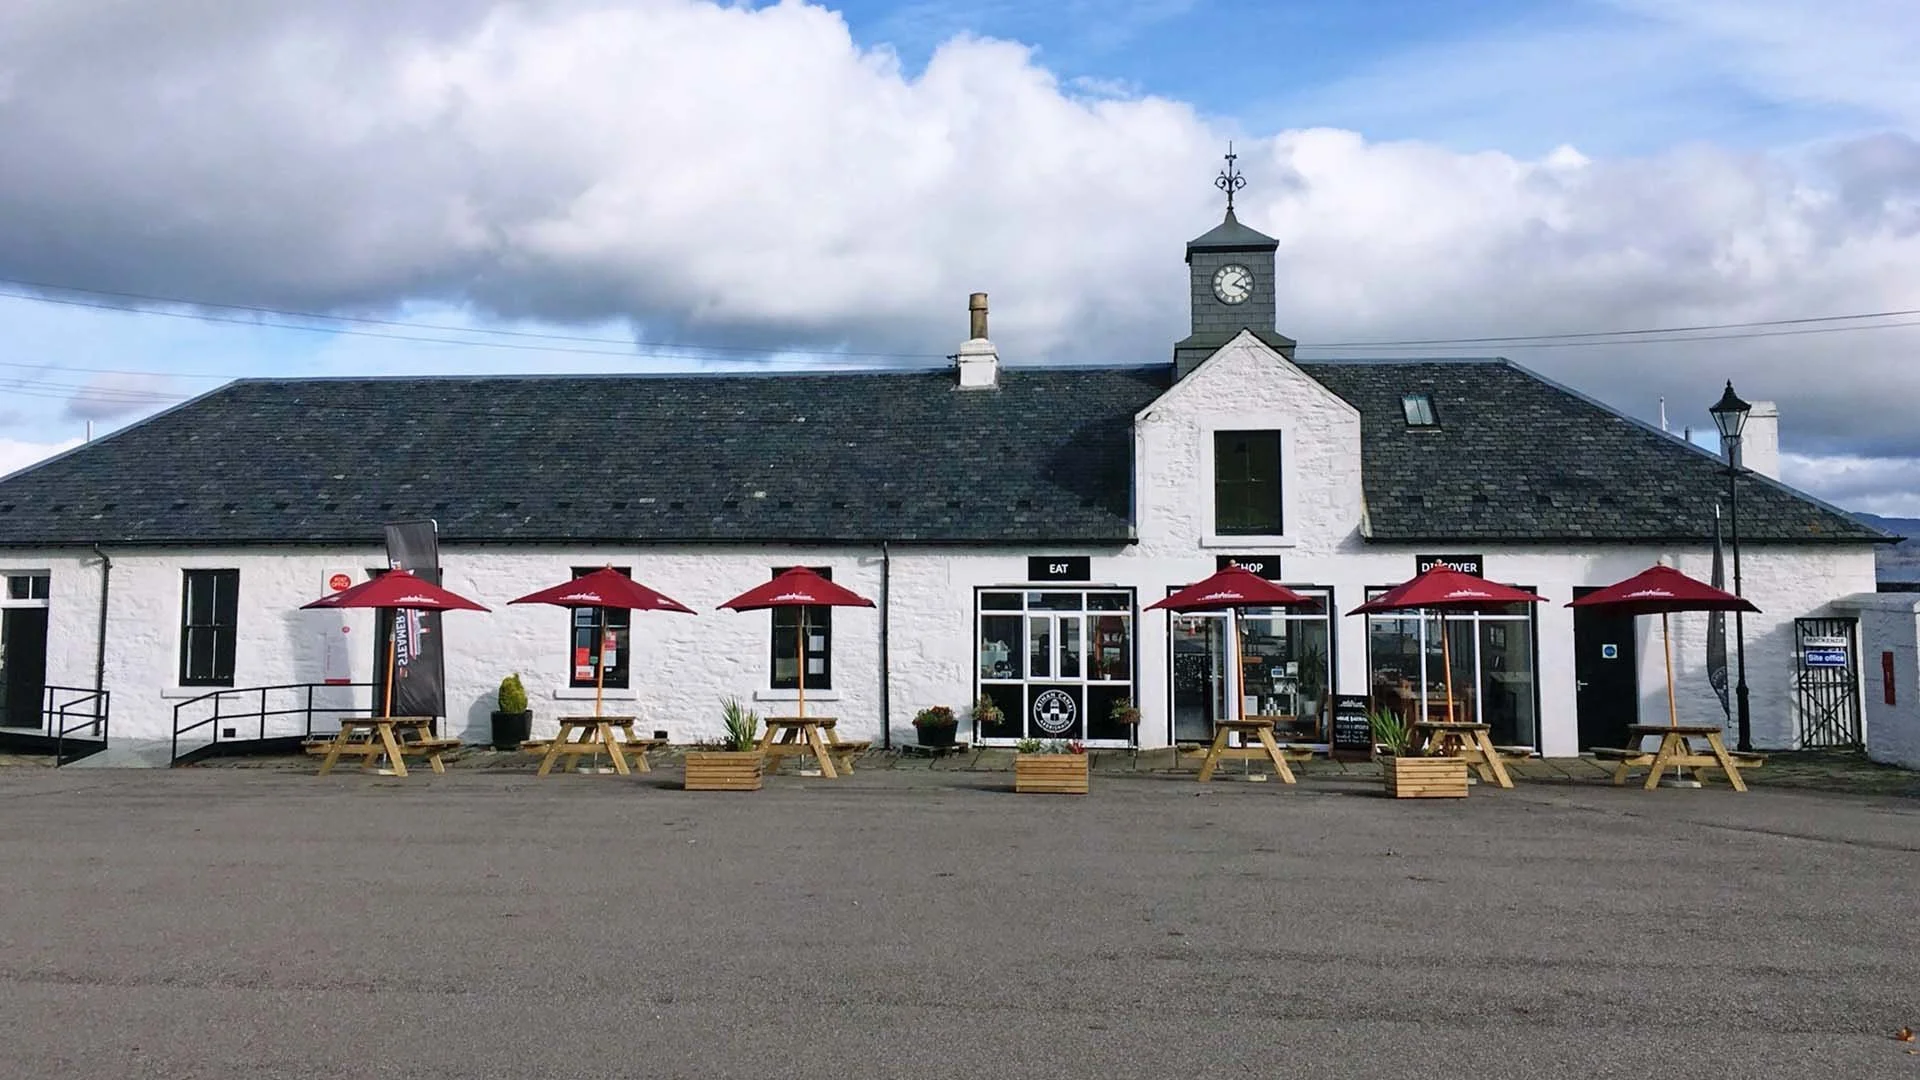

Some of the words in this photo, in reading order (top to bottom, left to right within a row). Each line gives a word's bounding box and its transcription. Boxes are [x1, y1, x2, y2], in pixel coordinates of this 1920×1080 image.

[1049, 563, 1069, 574] EAT
[1808, 653, 1823, 662] Site
[1824, 654, 1844, 662] office
